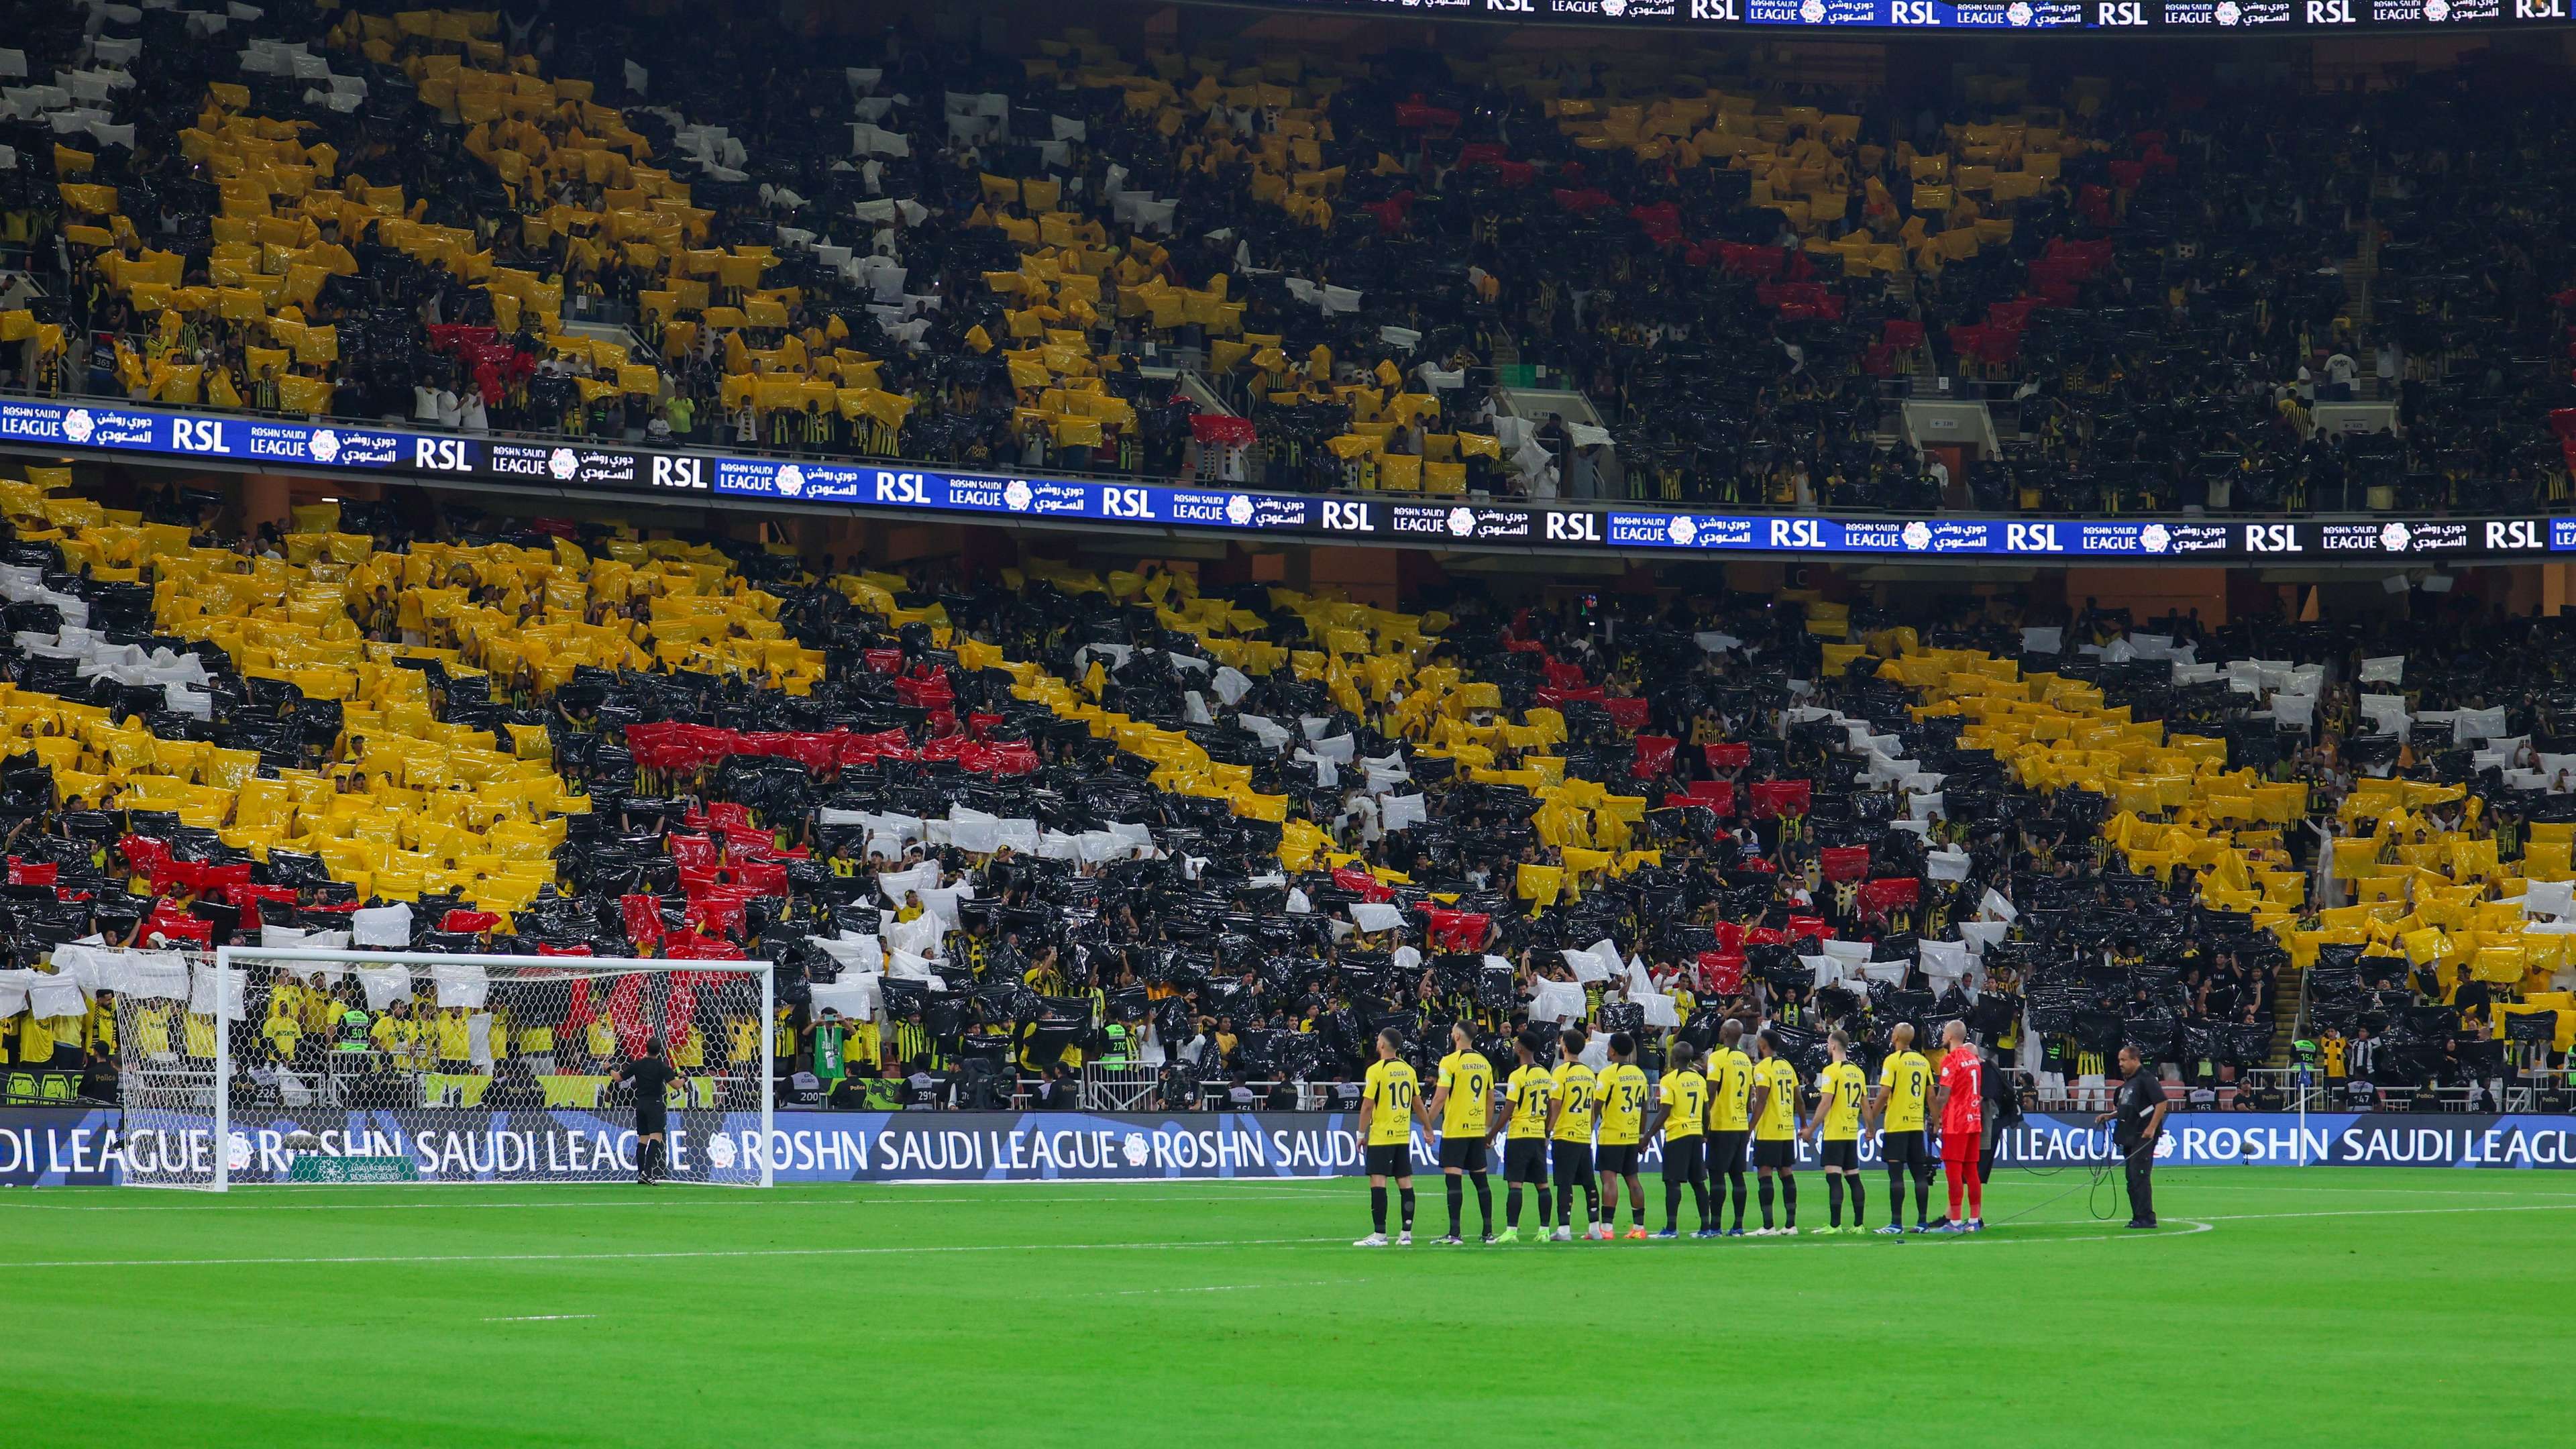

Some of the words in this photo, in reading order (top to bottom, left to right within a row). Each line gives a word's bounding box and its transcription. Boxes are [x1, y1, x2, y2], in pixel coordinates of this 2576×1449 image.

[1553, 1, 1597, 12] LEAGUE
[1692, 0, 1739, 19] RSL
[1829, 0, 1851, 9] روشن
[1854, 3, 1874, 11] دوري
[2035, 2, 2059, 12] روشن
[2060, 5, 2080, 13] دوري
[2243, 3, 2267, 11] روشن
[2268, 3, 2289, 13] دوري
[1629, 6, 1674, 17] السعودي
[1751, 9, 1796, 19] LEAGUE
[1829, 12, 1873, 23] السعودي
[1892, 1, 1940, 24] RSL
[1957, 12, 2004, 23] LEAGUE
[2100, 3, 2147, 25] RSL
[2165, 13, 2211, 23] LEAGUE
[2307, 0, 2355, 23] RSL
[2375, 9, 2420, 19] LEAGUE
[2453, 7, 2498, 21] السعودي
[2035, 14, 2080, 27] السعودي
[2243, 13, 2289, 25] السعودي
[3, 407, 33, 417] ROSHN
[35, 409, 60, 419] SAUDI
[97, 413, 125, 427] روشن
[127, 418, 152, 429] دوري
[3, 418, 59, 436] LEAGUE
[252, 427, 280, 437] ROSHN
[282, 430, 306, 439] SAUDI
[97, 431, 151, 445] السعودي
[173, 419, 229, 452] RSL
[343, 433, 370, 446] روشن
[251, 439, 305, 456] LEAGUE
[372, 438, 396, 449] دوري
[342, 451, 396, 464] السعودي
[417, 438, 472, 471] RSL
[494, 446, 520, 455] ROSHN
[523, 449, 545, 458] SAUDI
[582, 451, 608, 464] روشن
[493, 458, 545, 474] LEAGUE
[610, 456, 633, 468] دوري
[581, 468, 633, 482] السعودي
[653, 456, 707, 488] RSL
[721, 464, 748, 472] ROSHN
[749, 466, 773, 474] SAUDI
[807, 468, 833, 480] روشن
[720, 474, 772, 490] LEAGUE
[835, 472, 857, 483] دوري
[807, 484, 857, 498] السعودي
[877, 472, 930, 503] RSL
[951, 480, 977, 488] ROSHN
[979, 481, 1001, 490] SAUDI
[1035, 483, 1061, 496] روشن
[950, 490, 1000, 506] LEAGUE
[1062, 488, 1083, 498] دوري
[1175, 494, 1200, 503] ROSHN
[1201, 496, 1224, 504] SAUDI
[1034, 500, 1083, 513] السعودي
[1104, 488, 1155, 518] RSL
[1256, 498, 1281, 510] روشن
[1283, 502, 1304, 513] دوري
[1174, 504, 1222, 520] LEAGUE
[1323, 501, 1374, 531] RSL
[1395, 507, 1419, 515] ROSHN
[1421, 508, 1444, 517] SAUDI
[1479, 510, 1503, 521] روشن
[1505, 513, 1527, 524] دوري
[1256, 513, 1304, 526] السعودي
[1394, 517, 1444, 532] LEAGUE
[1700, 518, 1726, 529] روشن
[1727, 521, 1750, 531] دوري
[1478, 525, 1527, 537] السعودي
[1547, 513, 1600, 540] RSL
[1934, 523, 1962, 534] روشن
[1963, 526, 1986, 536] دوري
[2173, 525, 2200, 536] روشن
[2202, 528, 2225, 538] دوري
[2413, 523, 2440, 535] روشن
[2442, 525, 2466, 536] دوري
[1613, 527, 1664, 541] LEAGUE
[1699, 532, 1750, 546] السعودي
[1771, 520, 1825, 547] RSL
[1846, 533, 1898, 547] LEAGUE
[2008, 524, 2063, 550] RSL
[2247, 525, 2302, 551] RSL
[2487, 521, 2542, 548] RSL
[1934, 537, 1986, 551] السعودي
[2084, 537, 2136, 549] LEAGUE
[2173, 538, 2225, 553] السعودي
[2324, 536, 2376, 548] LEAGUE
[2414, 536, 2466, 551] السعودي
[1470, 1074, 1483, 1103] 9
[1911, 1071, 1921, 1097] 8
[1971, 1069, 1978, 1095] 1
[800, 1092, 818, 1101] 200
[918, 1091, 932, 1100] 291
[1388, 1081, 1411, 1110] 10
[1777, 1079, 1792, 1106] 15
[1844, 1082, 1861, 1108] 12
[1686, 1091, 1697, 1118] 7
[48, 1129, 212, 1173] LEAGUE
[418, 1130, 537, 1172] SAUDI
[741, 1130, 869, 1171] ROSHN
[881, 1130, 984, 1171] SAUDI
[991, 1130, 1118, 1169] LEAGUE
[1154, 1130, 1263, 1168] ROSHN
[2183, 1128, 2328, 1161] ROSHN
[2343, 1128, 2453, 1161] SAUDI
